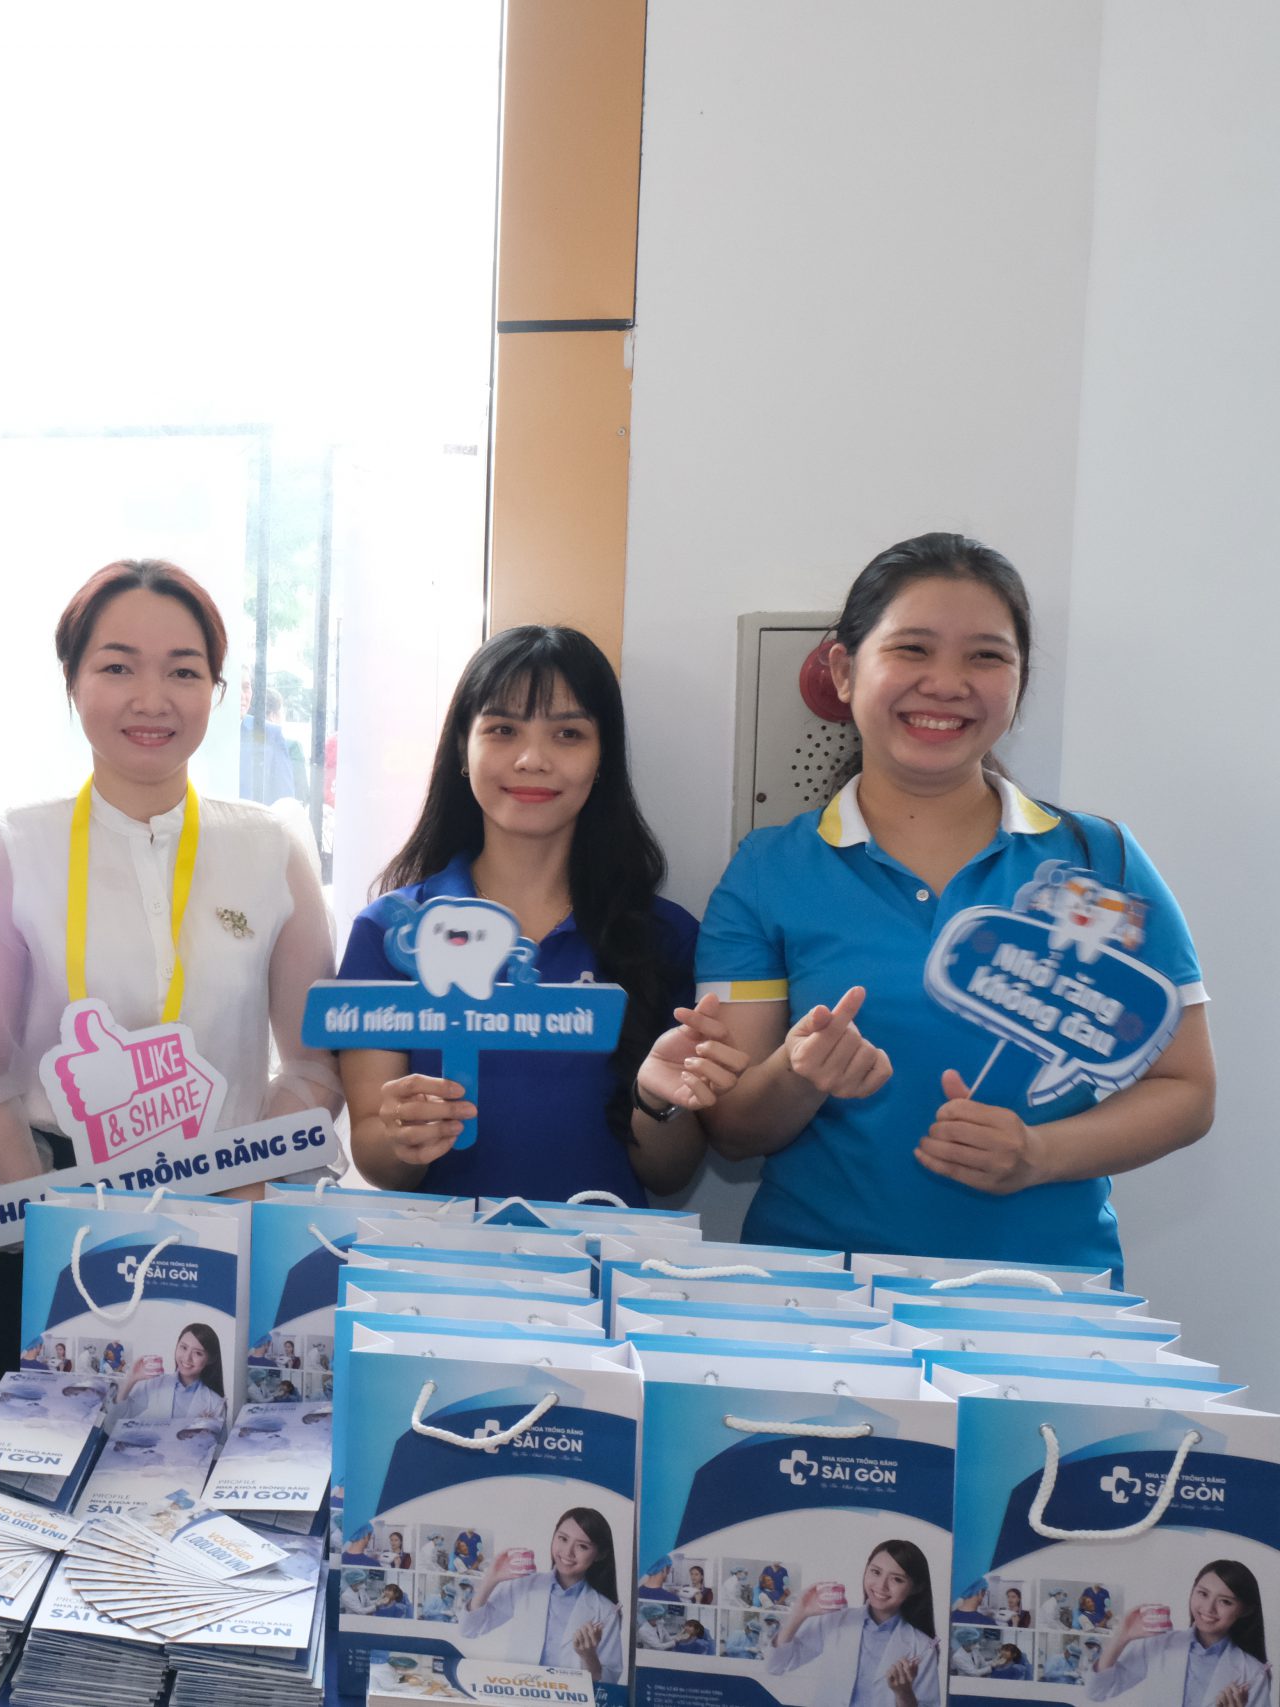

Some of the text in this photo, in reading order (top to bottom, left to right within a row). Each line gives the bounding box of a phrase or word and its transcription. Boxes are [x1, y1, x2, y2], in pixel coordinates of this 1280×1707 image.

[1051, 971, 1126, 1027] răng
[463, 1009, 509, 1033] Trao
[514, 1012, 541, 1038] nụ
[136, 1040, 187, 1085] LIKE
[109, 1078, 203, 1147] & SHARE
[118, 1151, 211, 1193] TRỒNG
[216, 1137, 288, 1171] RĂNG
[292, 1125, 327, 1152] SG
[146, 1265, 198, 1281] SÀI GÒN
[513, 1433, 583, 1453] SÀI GÒN
[821, 1463, 897, 1484] SÀI GÒN
[1180, 1483, 1225, 1502] GÒN
[472, 1683, 589, 1703] 1.000.000 VND
[486, 1675, 569, 1691] VOUCHER
